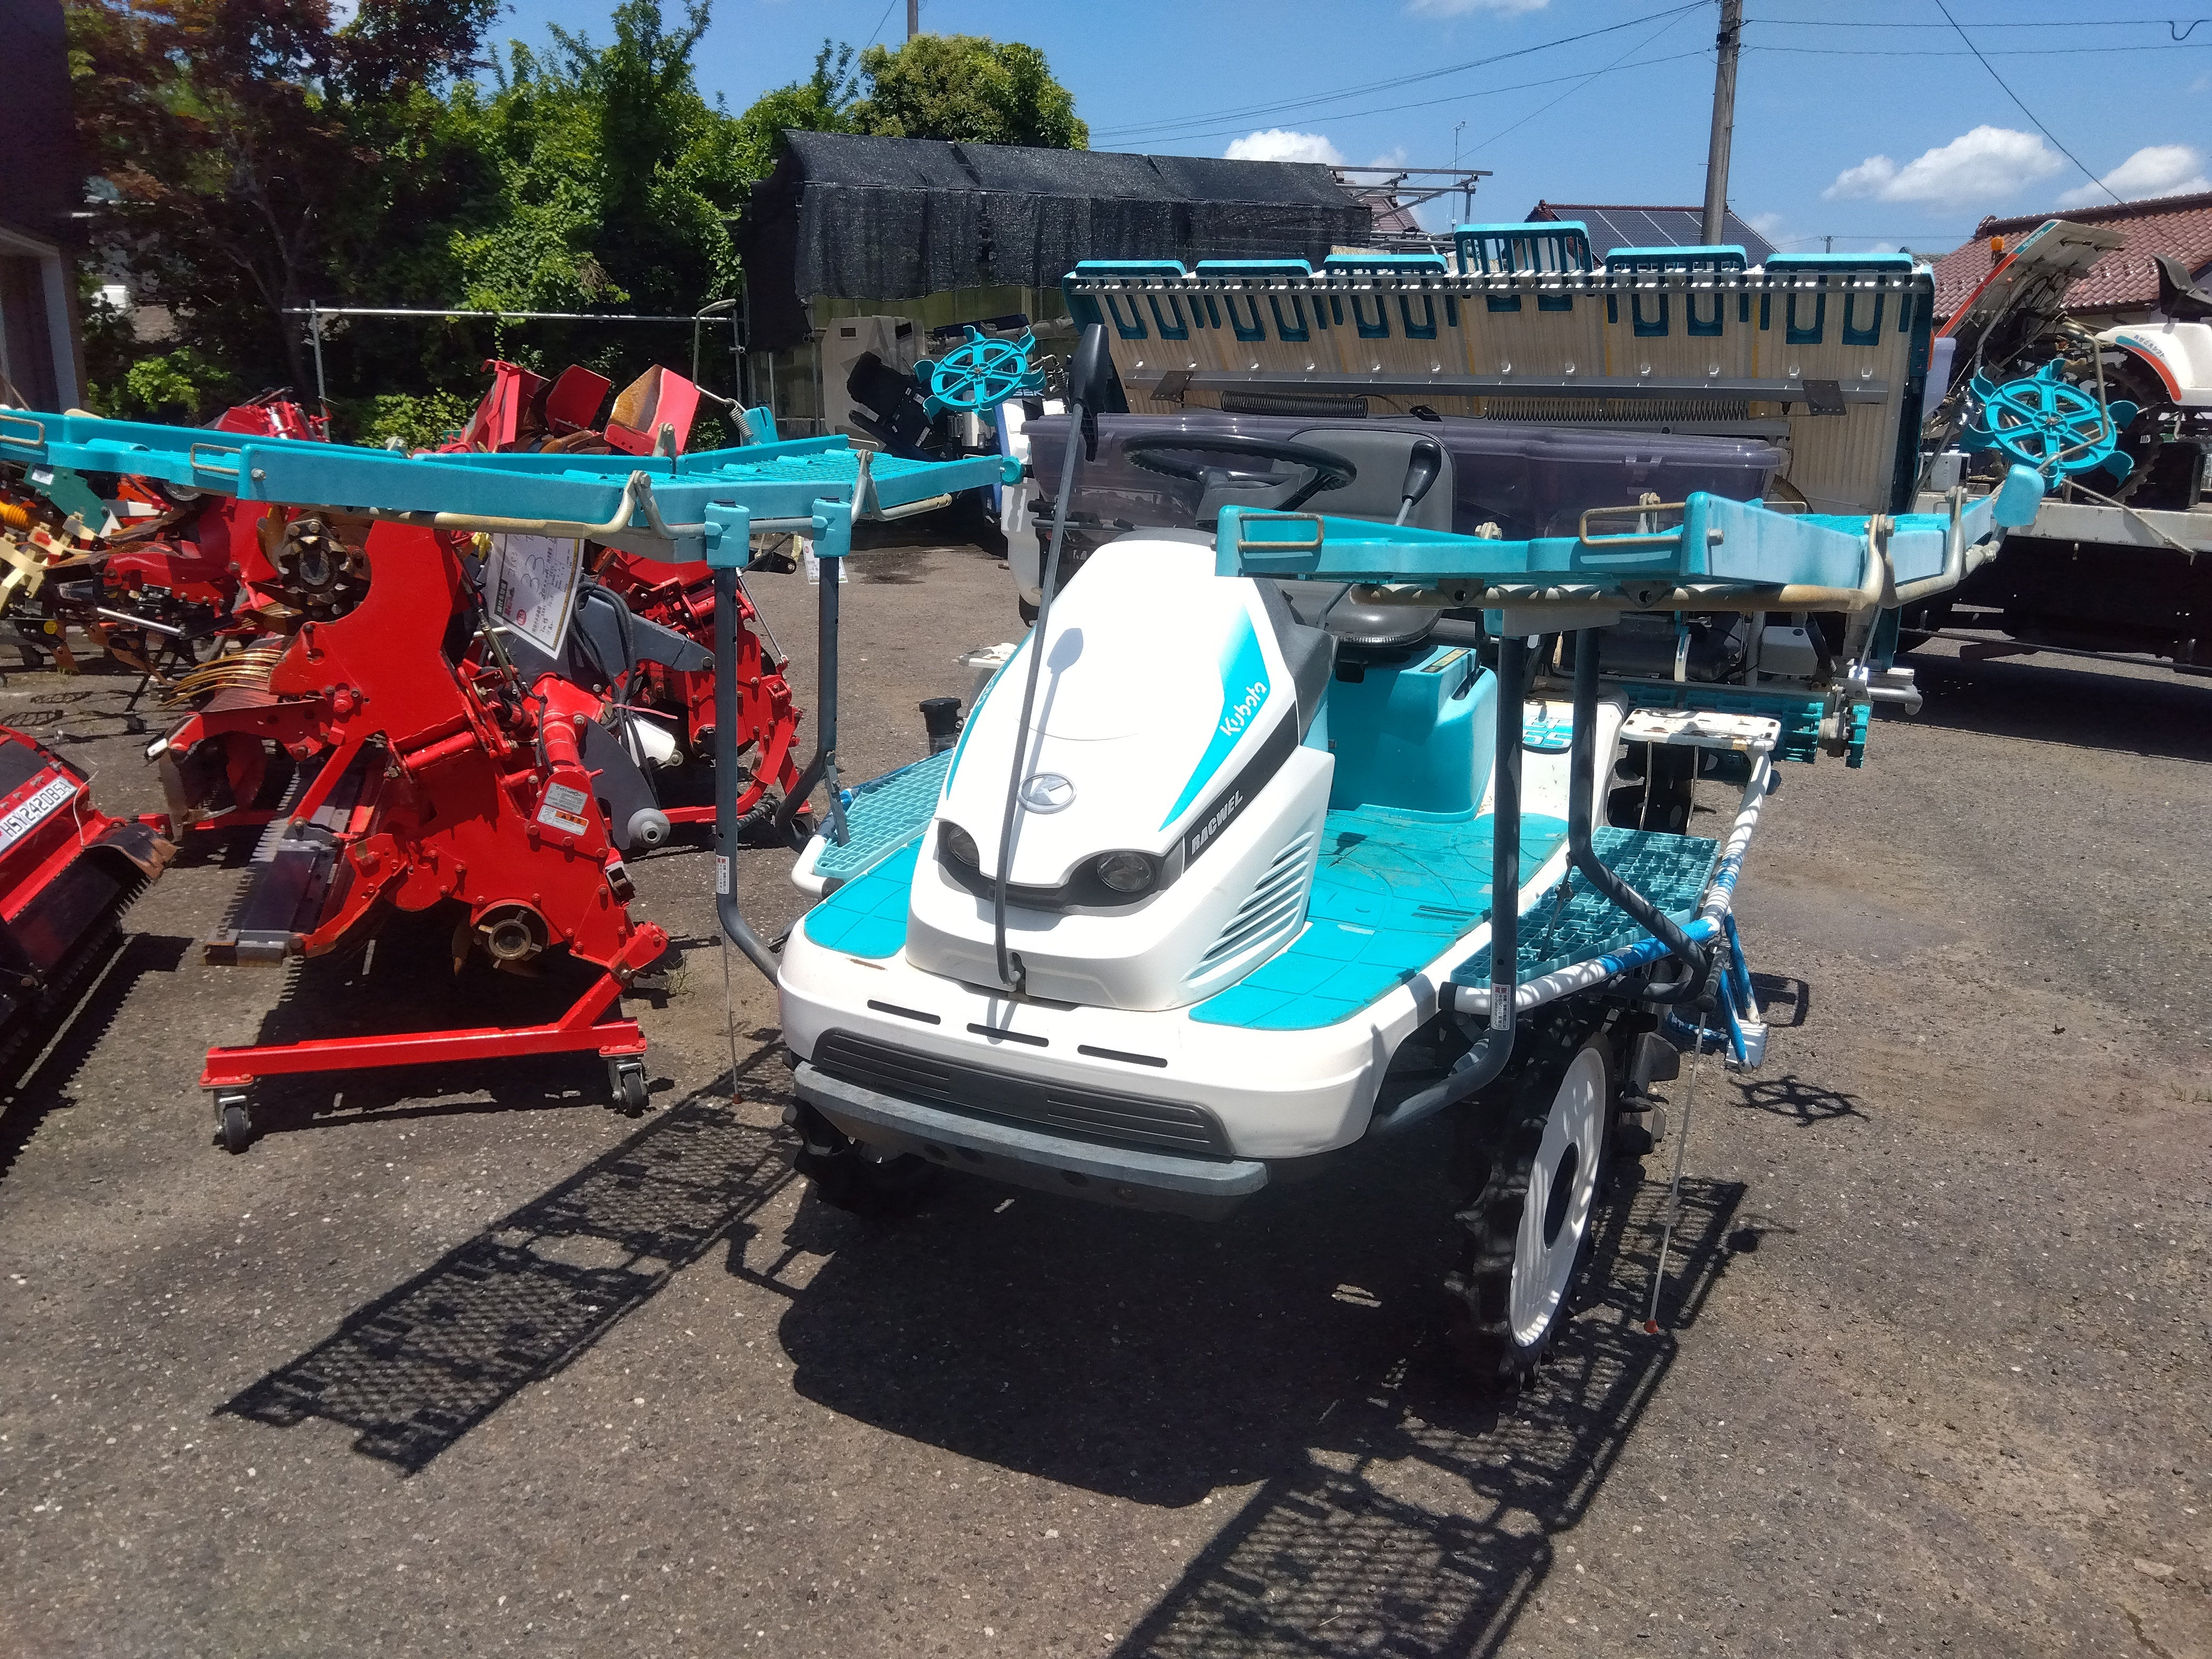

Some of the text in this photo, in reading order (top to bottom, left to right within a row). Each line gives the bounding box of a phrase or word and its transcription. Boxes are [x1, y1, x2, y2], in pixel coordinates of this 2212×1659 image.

[2022, 231, 2044, 247] Kubota
[1219, 682, 1267, 736] Kubota
[1192, 790, 1243, 855] RACWEL
